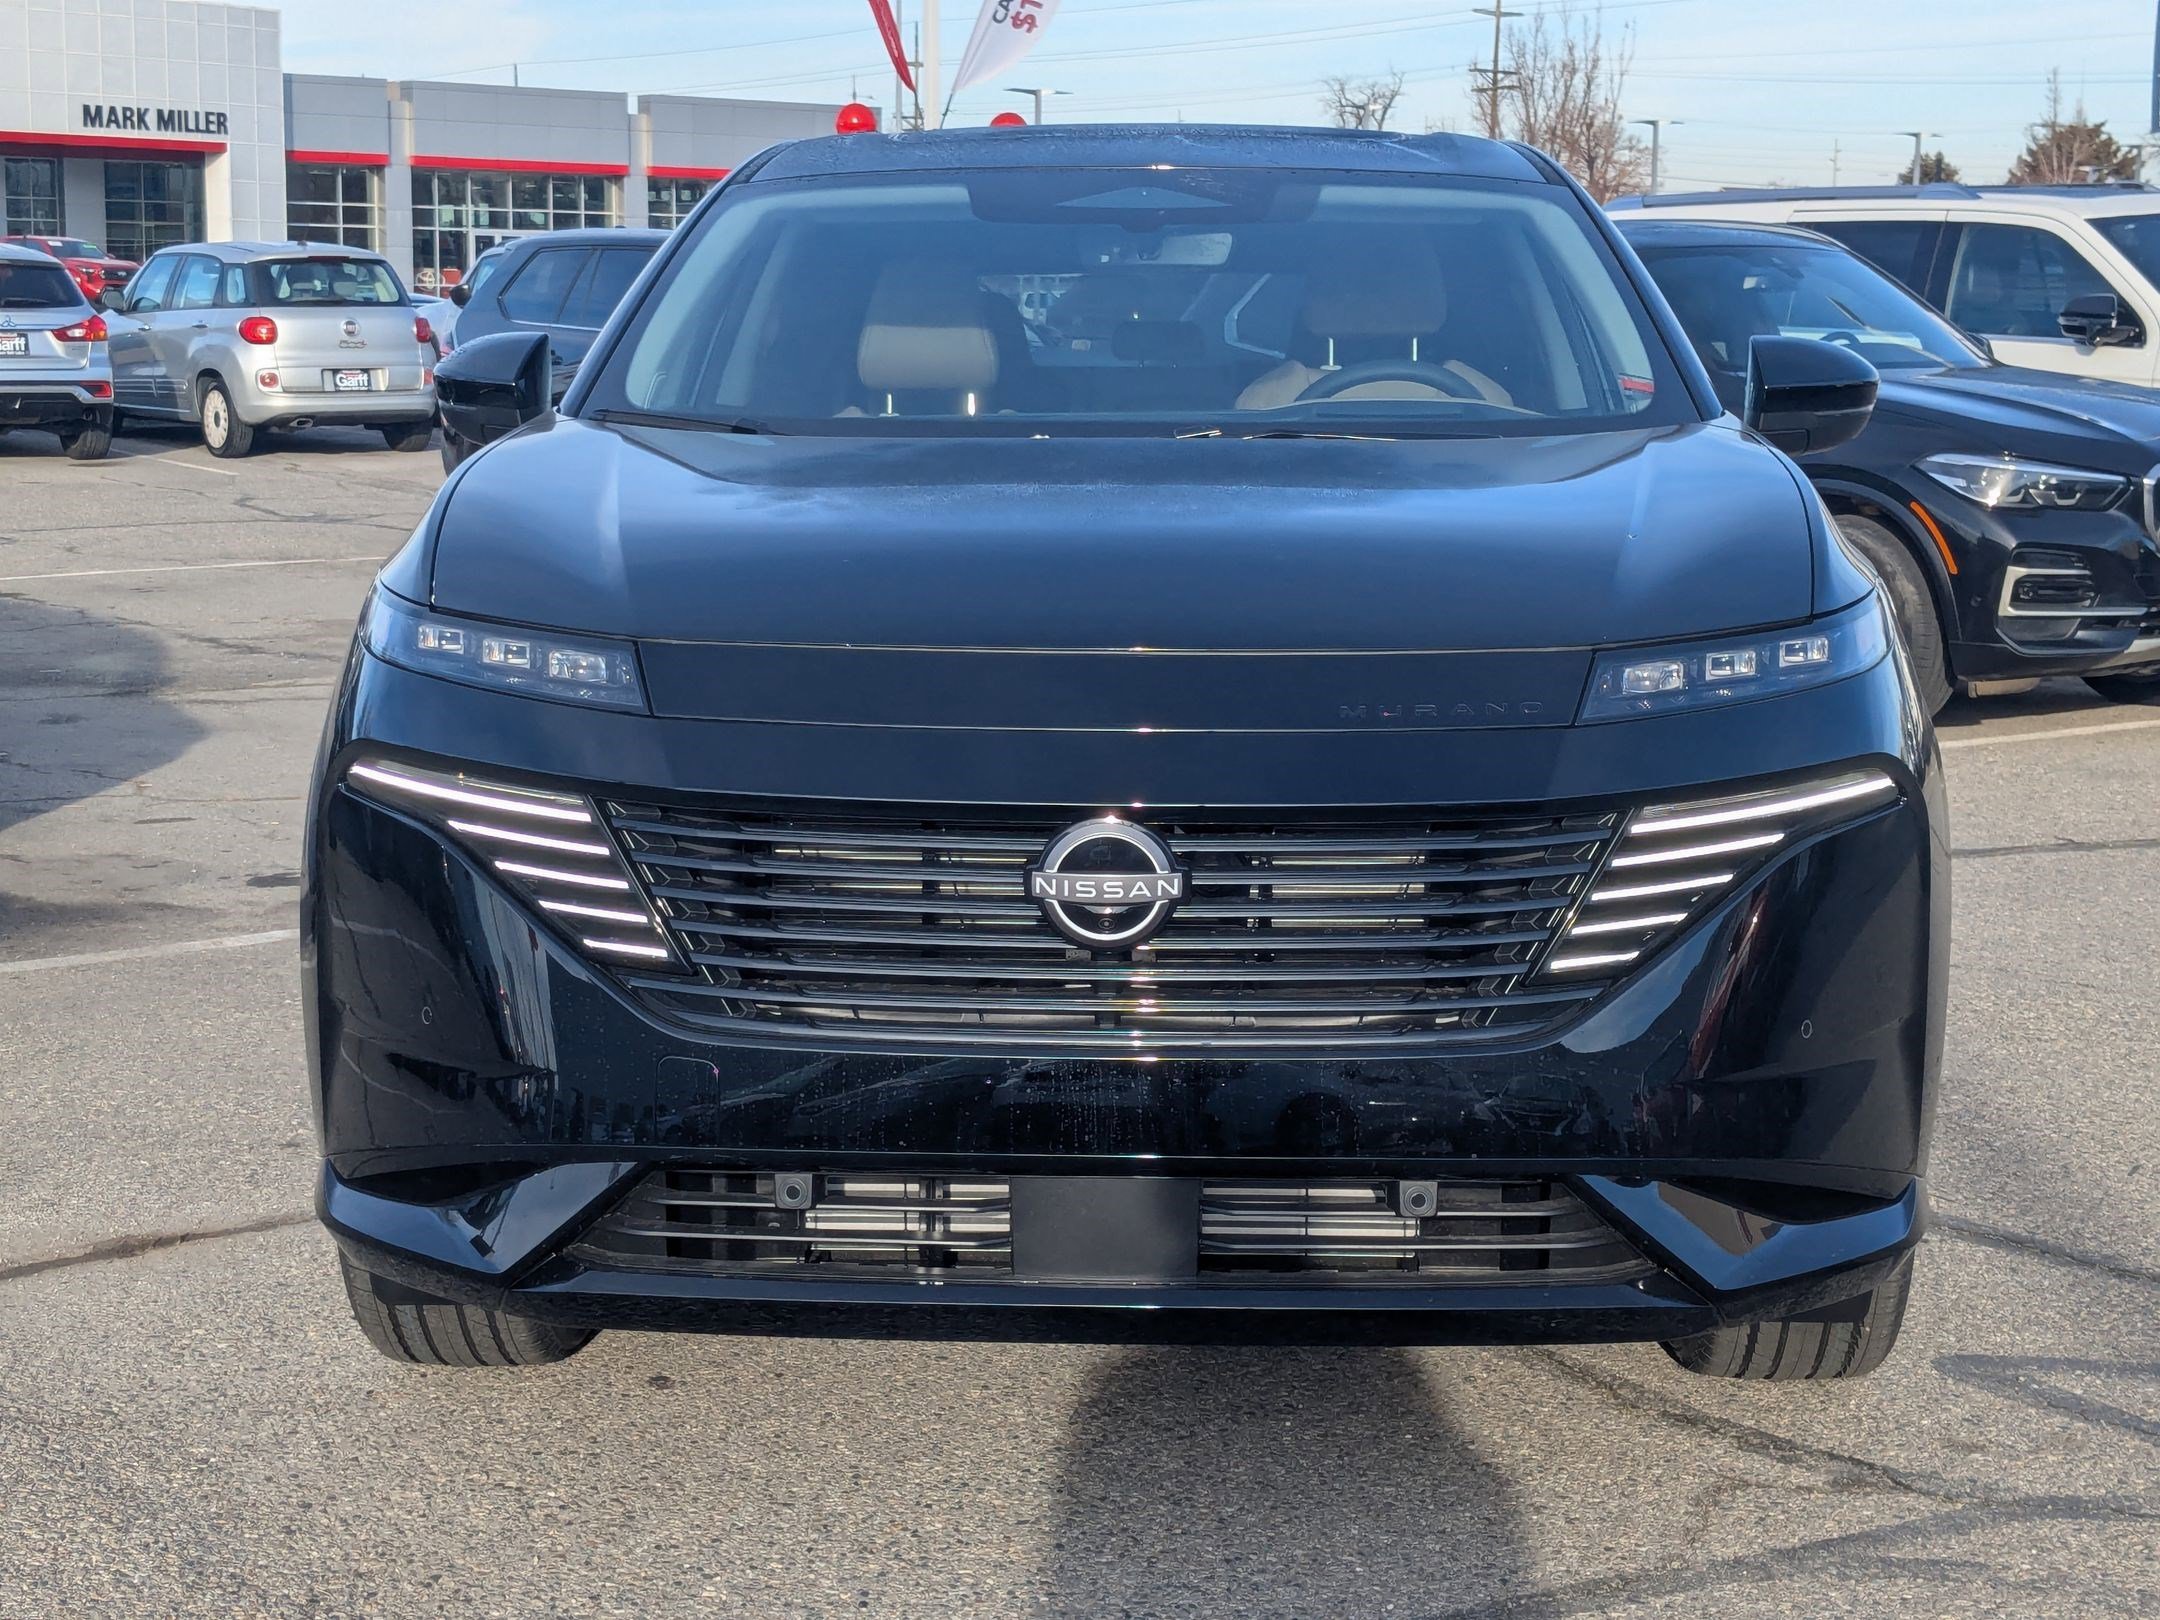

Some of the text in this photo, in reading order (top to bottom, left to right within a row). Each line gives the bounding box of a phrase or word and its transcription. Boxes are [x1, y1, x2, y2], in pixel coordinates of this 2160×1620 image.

[82, 104, 229, 135] MARK MILLER
[0, 337, 26, 351] arff
[336, 373, 369, 387] Garff
[1339, 701, 1544, 718] MURANO
[1035, 877, 1179, 899] NISSAN
